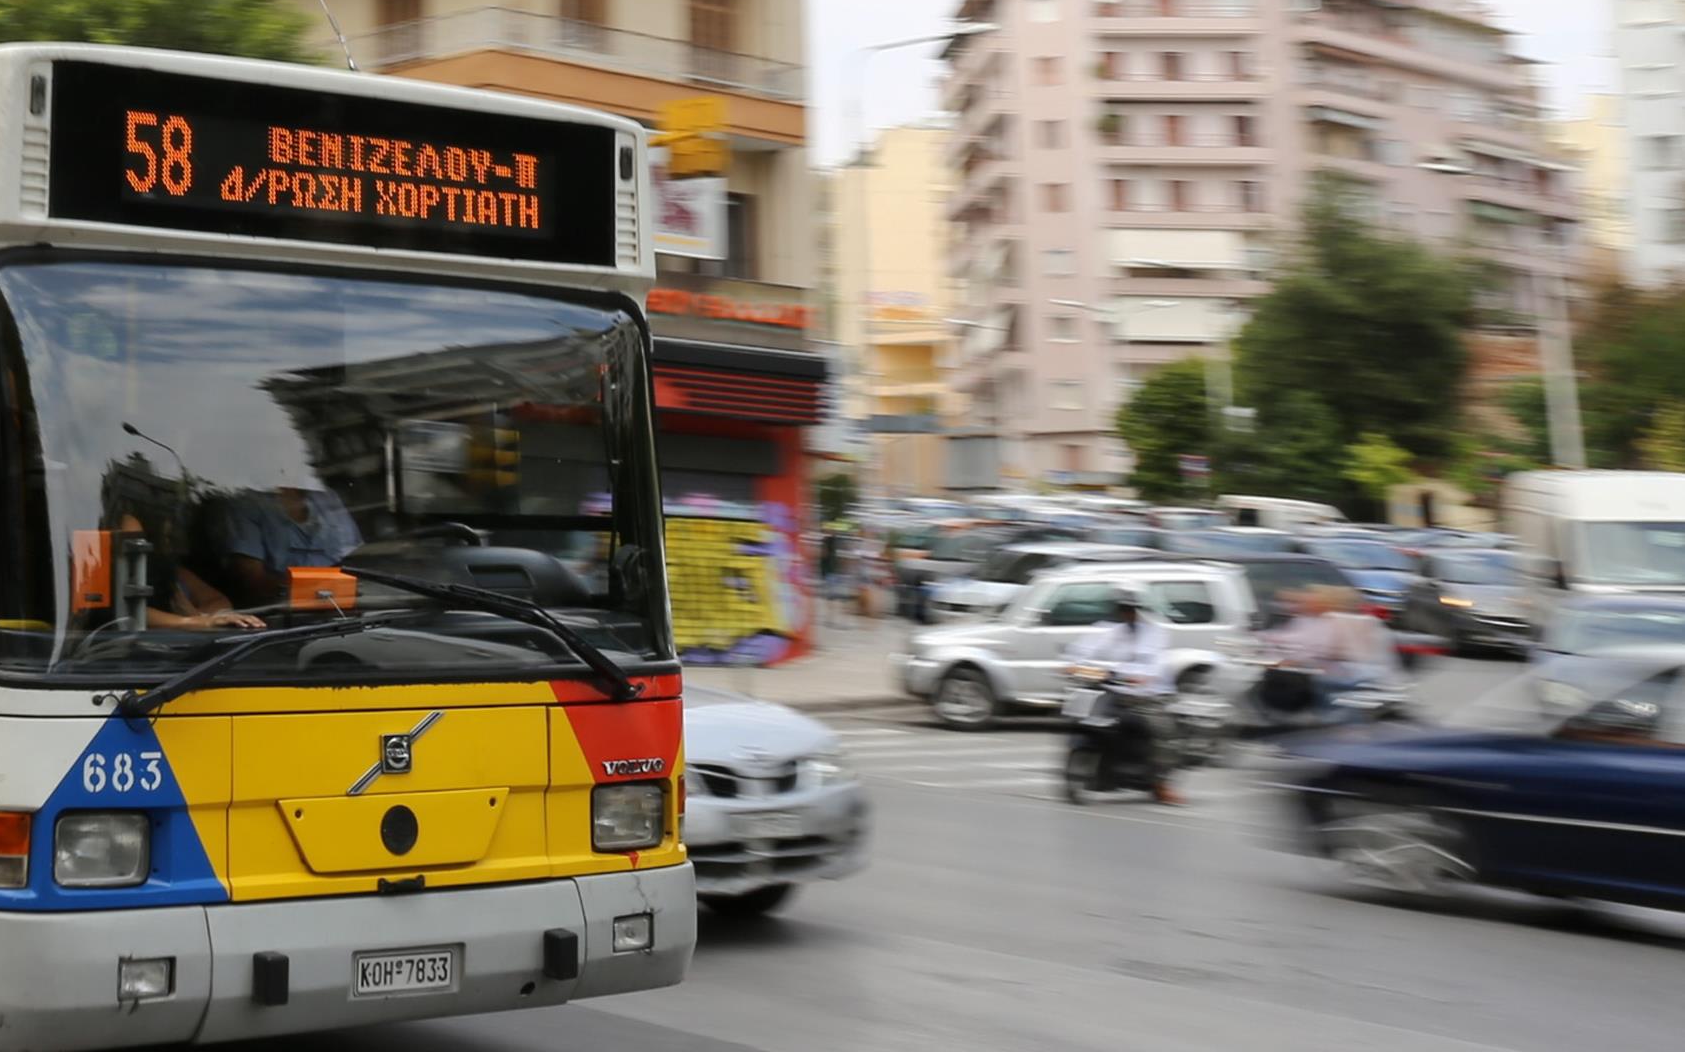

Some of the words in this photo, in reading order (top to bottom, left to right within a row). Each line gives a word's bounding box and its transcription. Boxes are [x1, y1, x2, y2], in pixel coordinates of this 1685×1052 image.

[126, 110, 192, 196] 58
[375, 179, 539, 229] ΧΟΡΤΙΑΤΗ
[83, 751, 162, 793] 683
[602, 757, 665, 775] VOLVO
